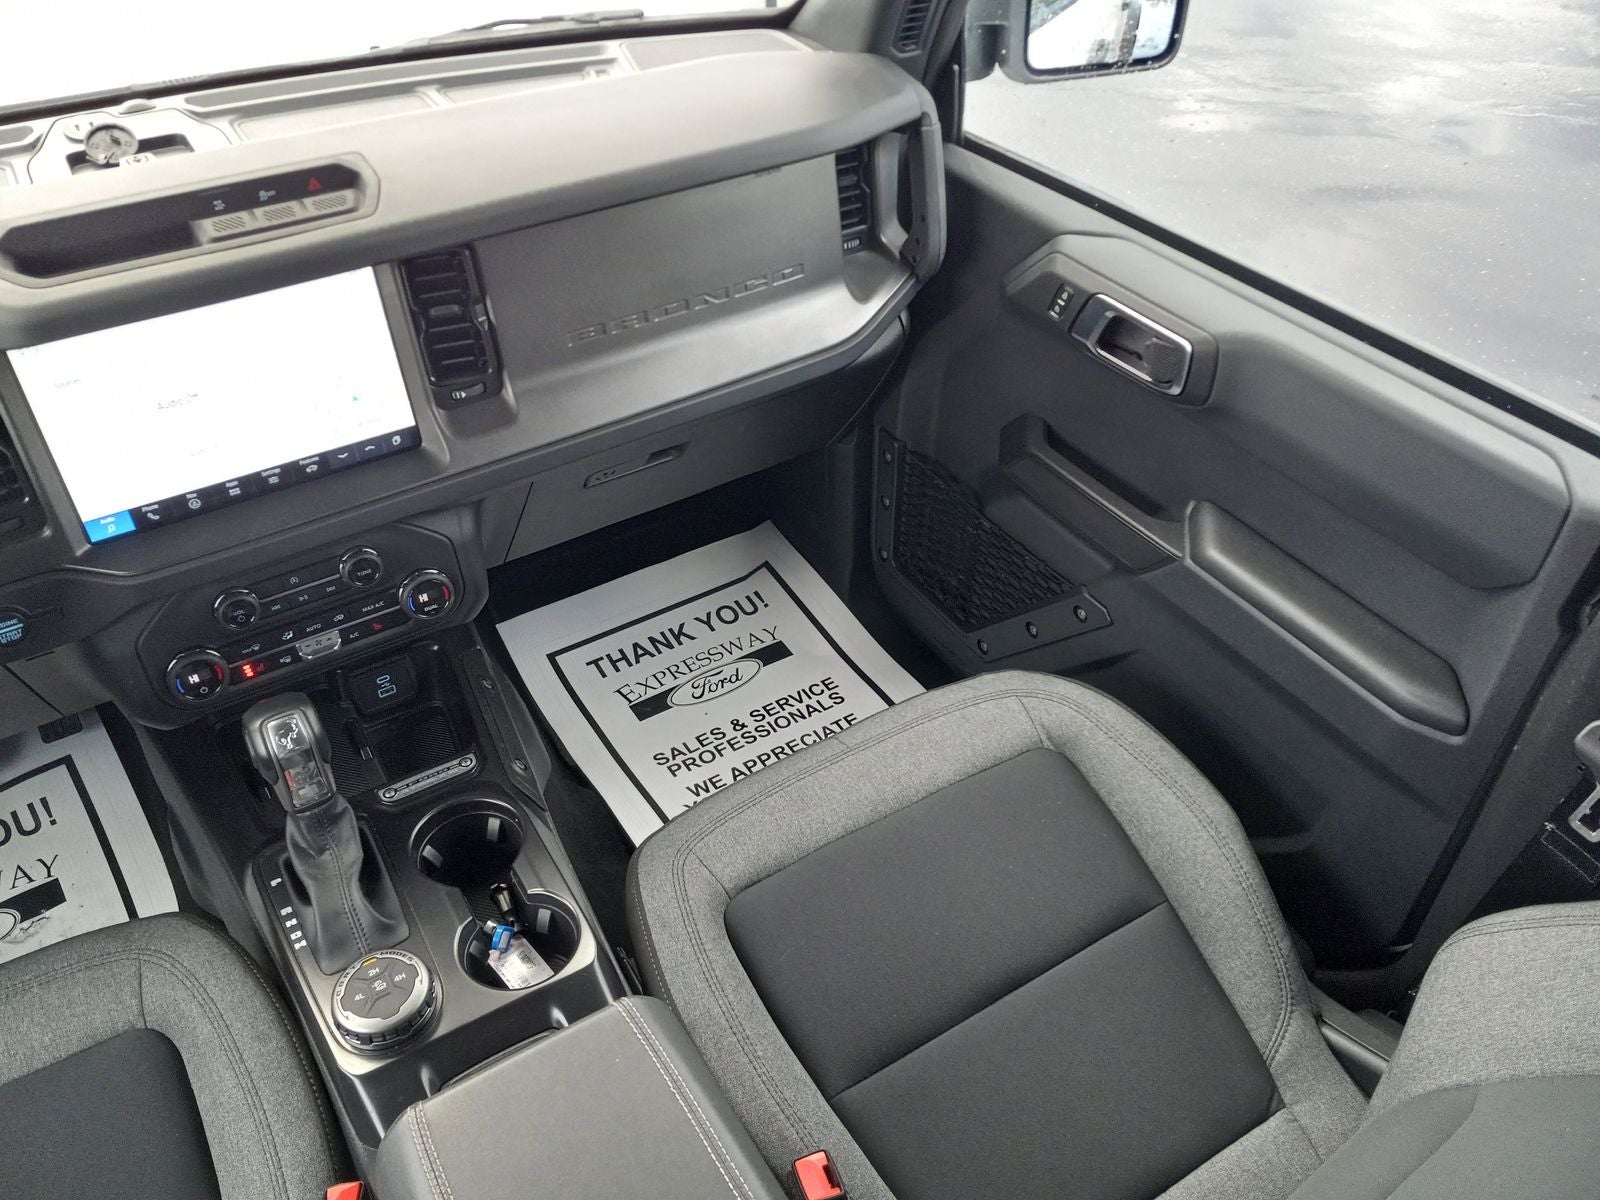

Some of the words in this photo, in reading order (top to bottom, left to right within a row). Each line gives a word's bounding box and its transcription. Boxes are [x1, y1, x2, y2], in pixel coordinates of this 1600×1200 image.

[566, 263, 805, 348] BRONCO
[357, 568, 372, 577] TUNE
[418, 593, 429, 603] HI
[361, 604, 375, 613] MAX
[375, 600, 385, 609] A/C
[424, 603, 439, 612] DUAL
[306, 623, 322, 632] AUTO
[586, 622, 698, 679] THANK
[693, 590, 769, 632] YOU!
[613, 625, 779, 705] EXPRESSWAY
[188, 673, 200, 684] HI
[691, 667, 744, 700] Ford
[653, 727, 726, 766] SALES
[730, 718, 749, 732] &
[749, 676, 839, 723] SERVICE
[667, 691, 845, 778] PROFESSIONALS
[686, 773, 728, 798] WE
[731, 713, 858, 782] APPRECIATE
[0, 854, 59, 890] AY
[285, 918, 297, 928] N
[290, 930, 303, 941] D
[379, 949, 415, 963] MODES
[367, 967, 380, 977] 2H
[393, 972, 407, 982] 4H
[354, 992, 367, 1001] 4L
